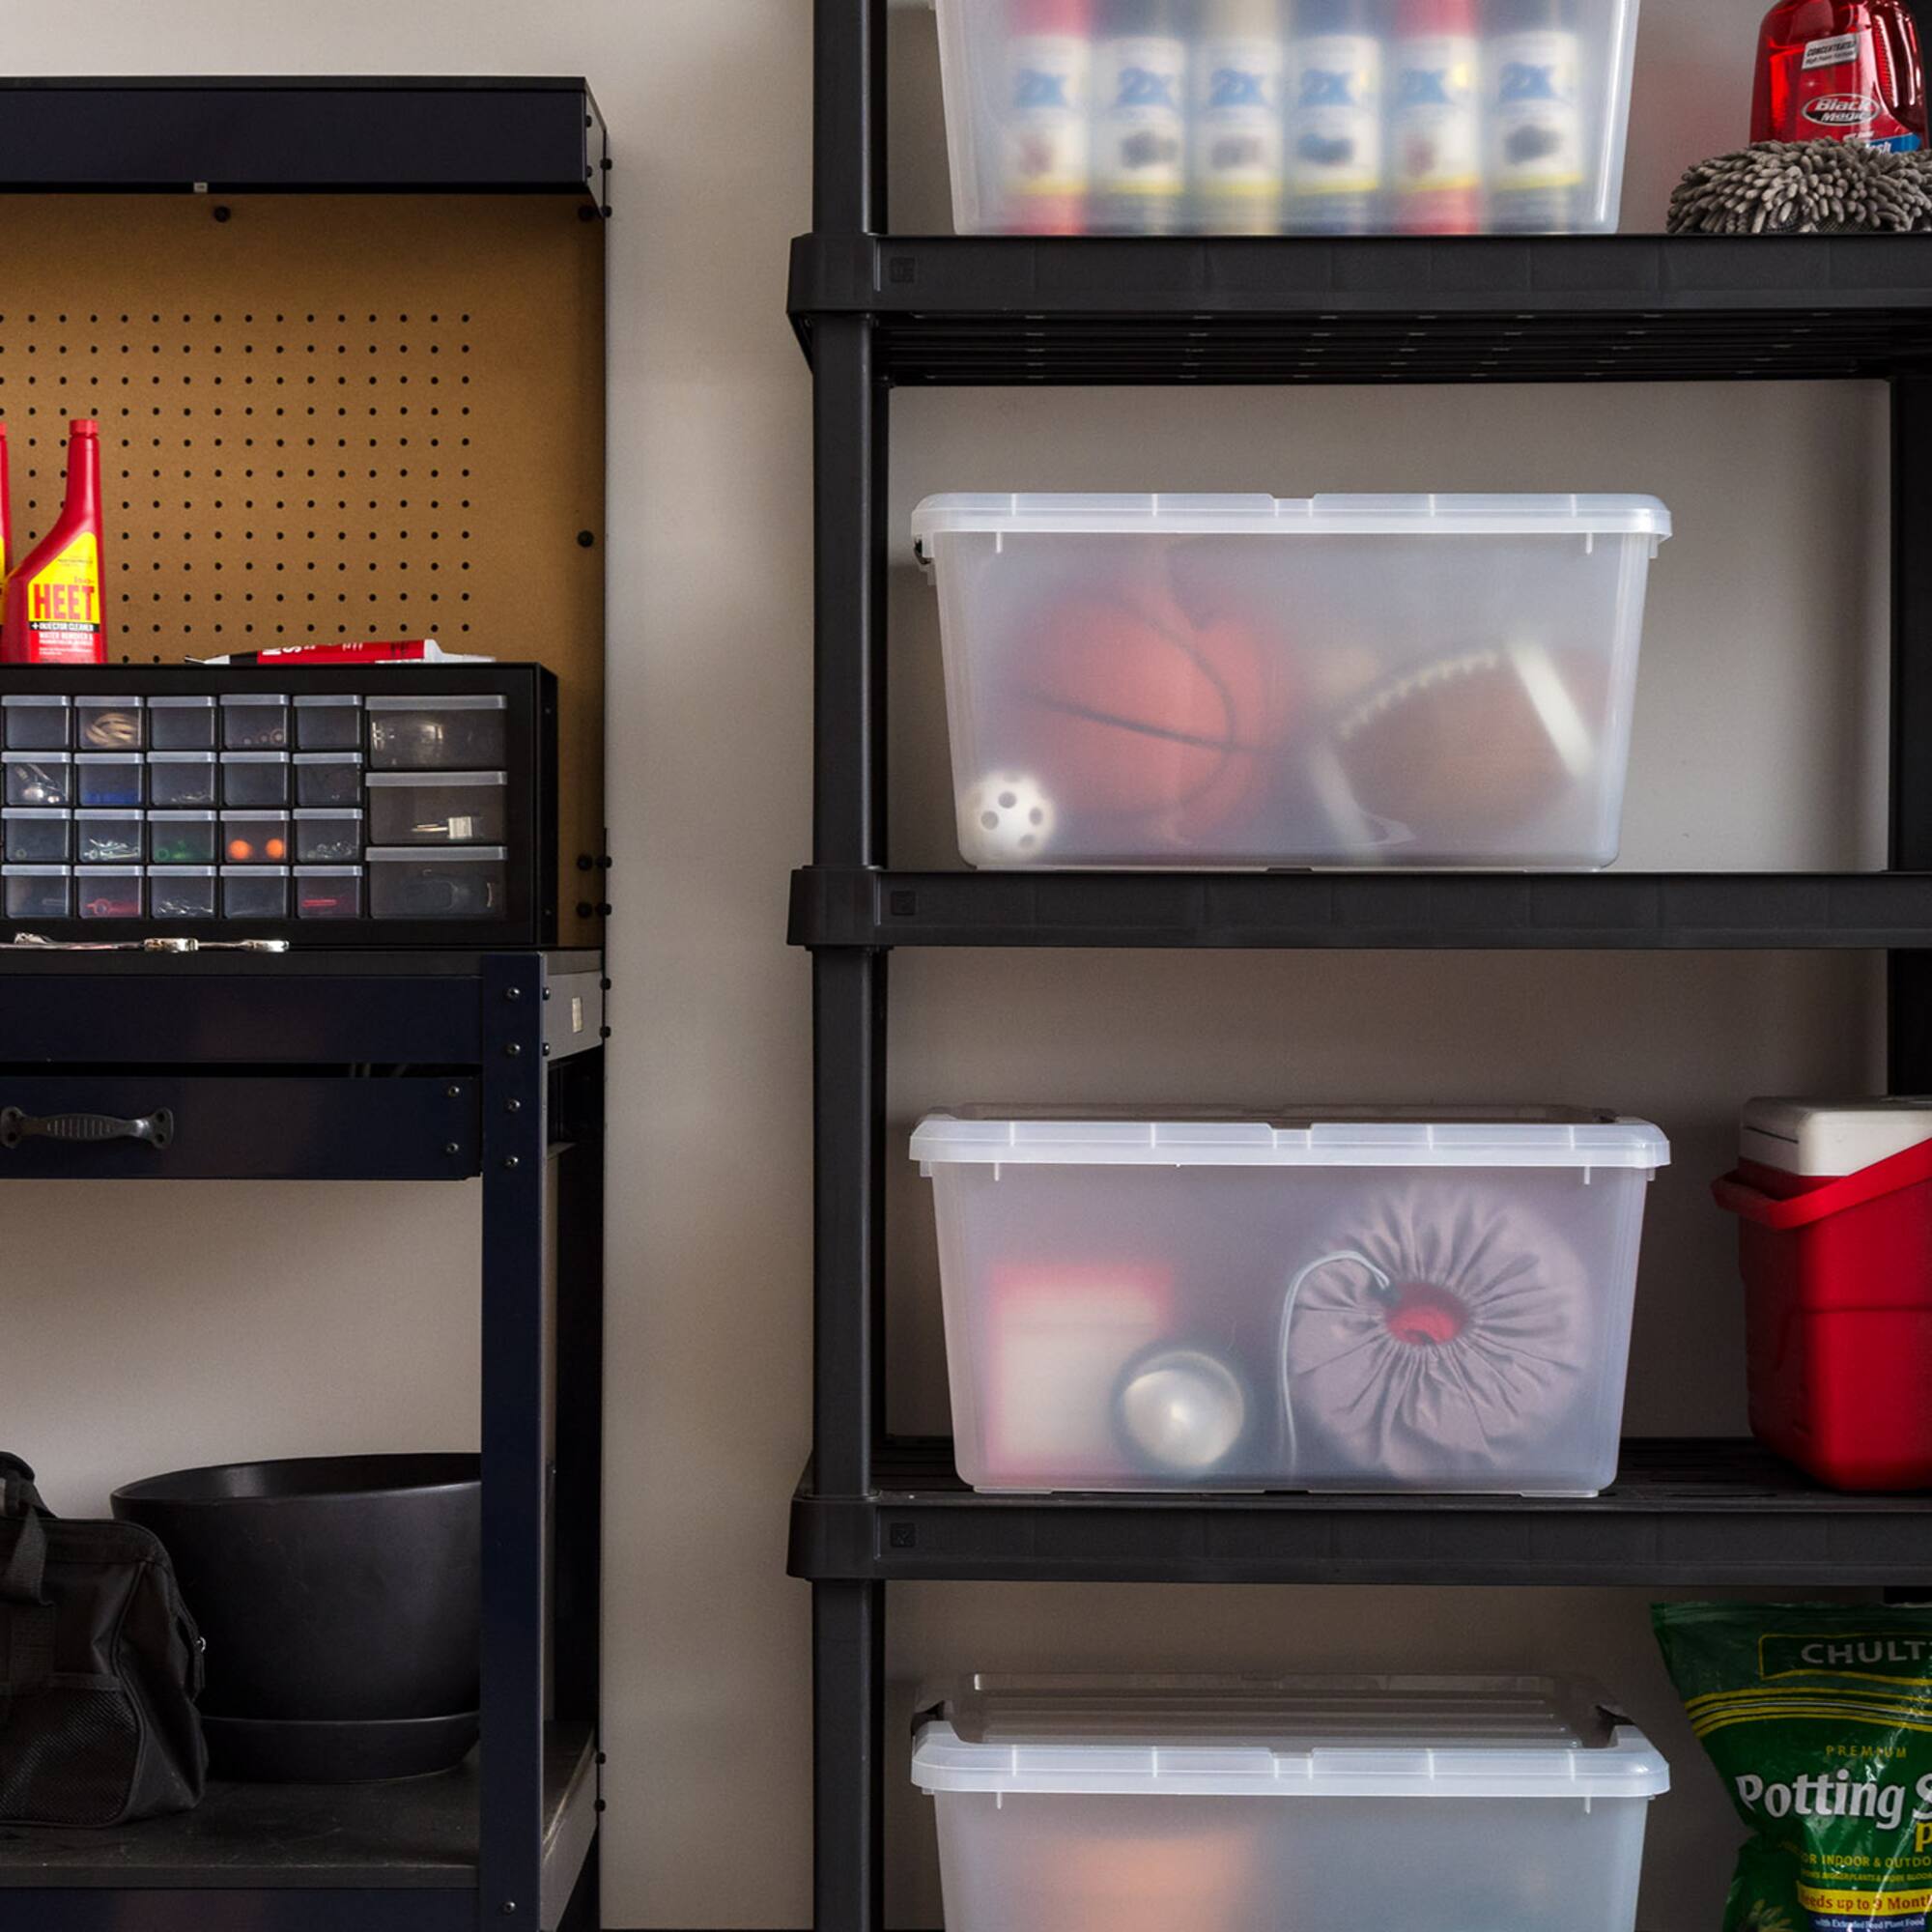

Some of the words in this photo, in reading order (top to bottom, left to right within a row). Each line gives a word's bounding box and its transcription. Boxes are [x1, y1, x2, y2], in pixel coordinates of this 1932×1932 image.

[1814, 98, 1872, 112] Black
[1821, 111, 1869, 123] Magic
[34, 583, 95, 620] HEET
[1826, 1745, 1907, 1758] PREMIUM
[1735, 1769, 1906, 1830] Potting
[1821, 1854, 1870, 1867] INDOOR
[1874, 1857, 1881, 1867] &
[1836, 1899, 1854, 1912] up
[1857, 1898, 1870, 1911] to
[1905, 1918, 1925, 1928] Food
